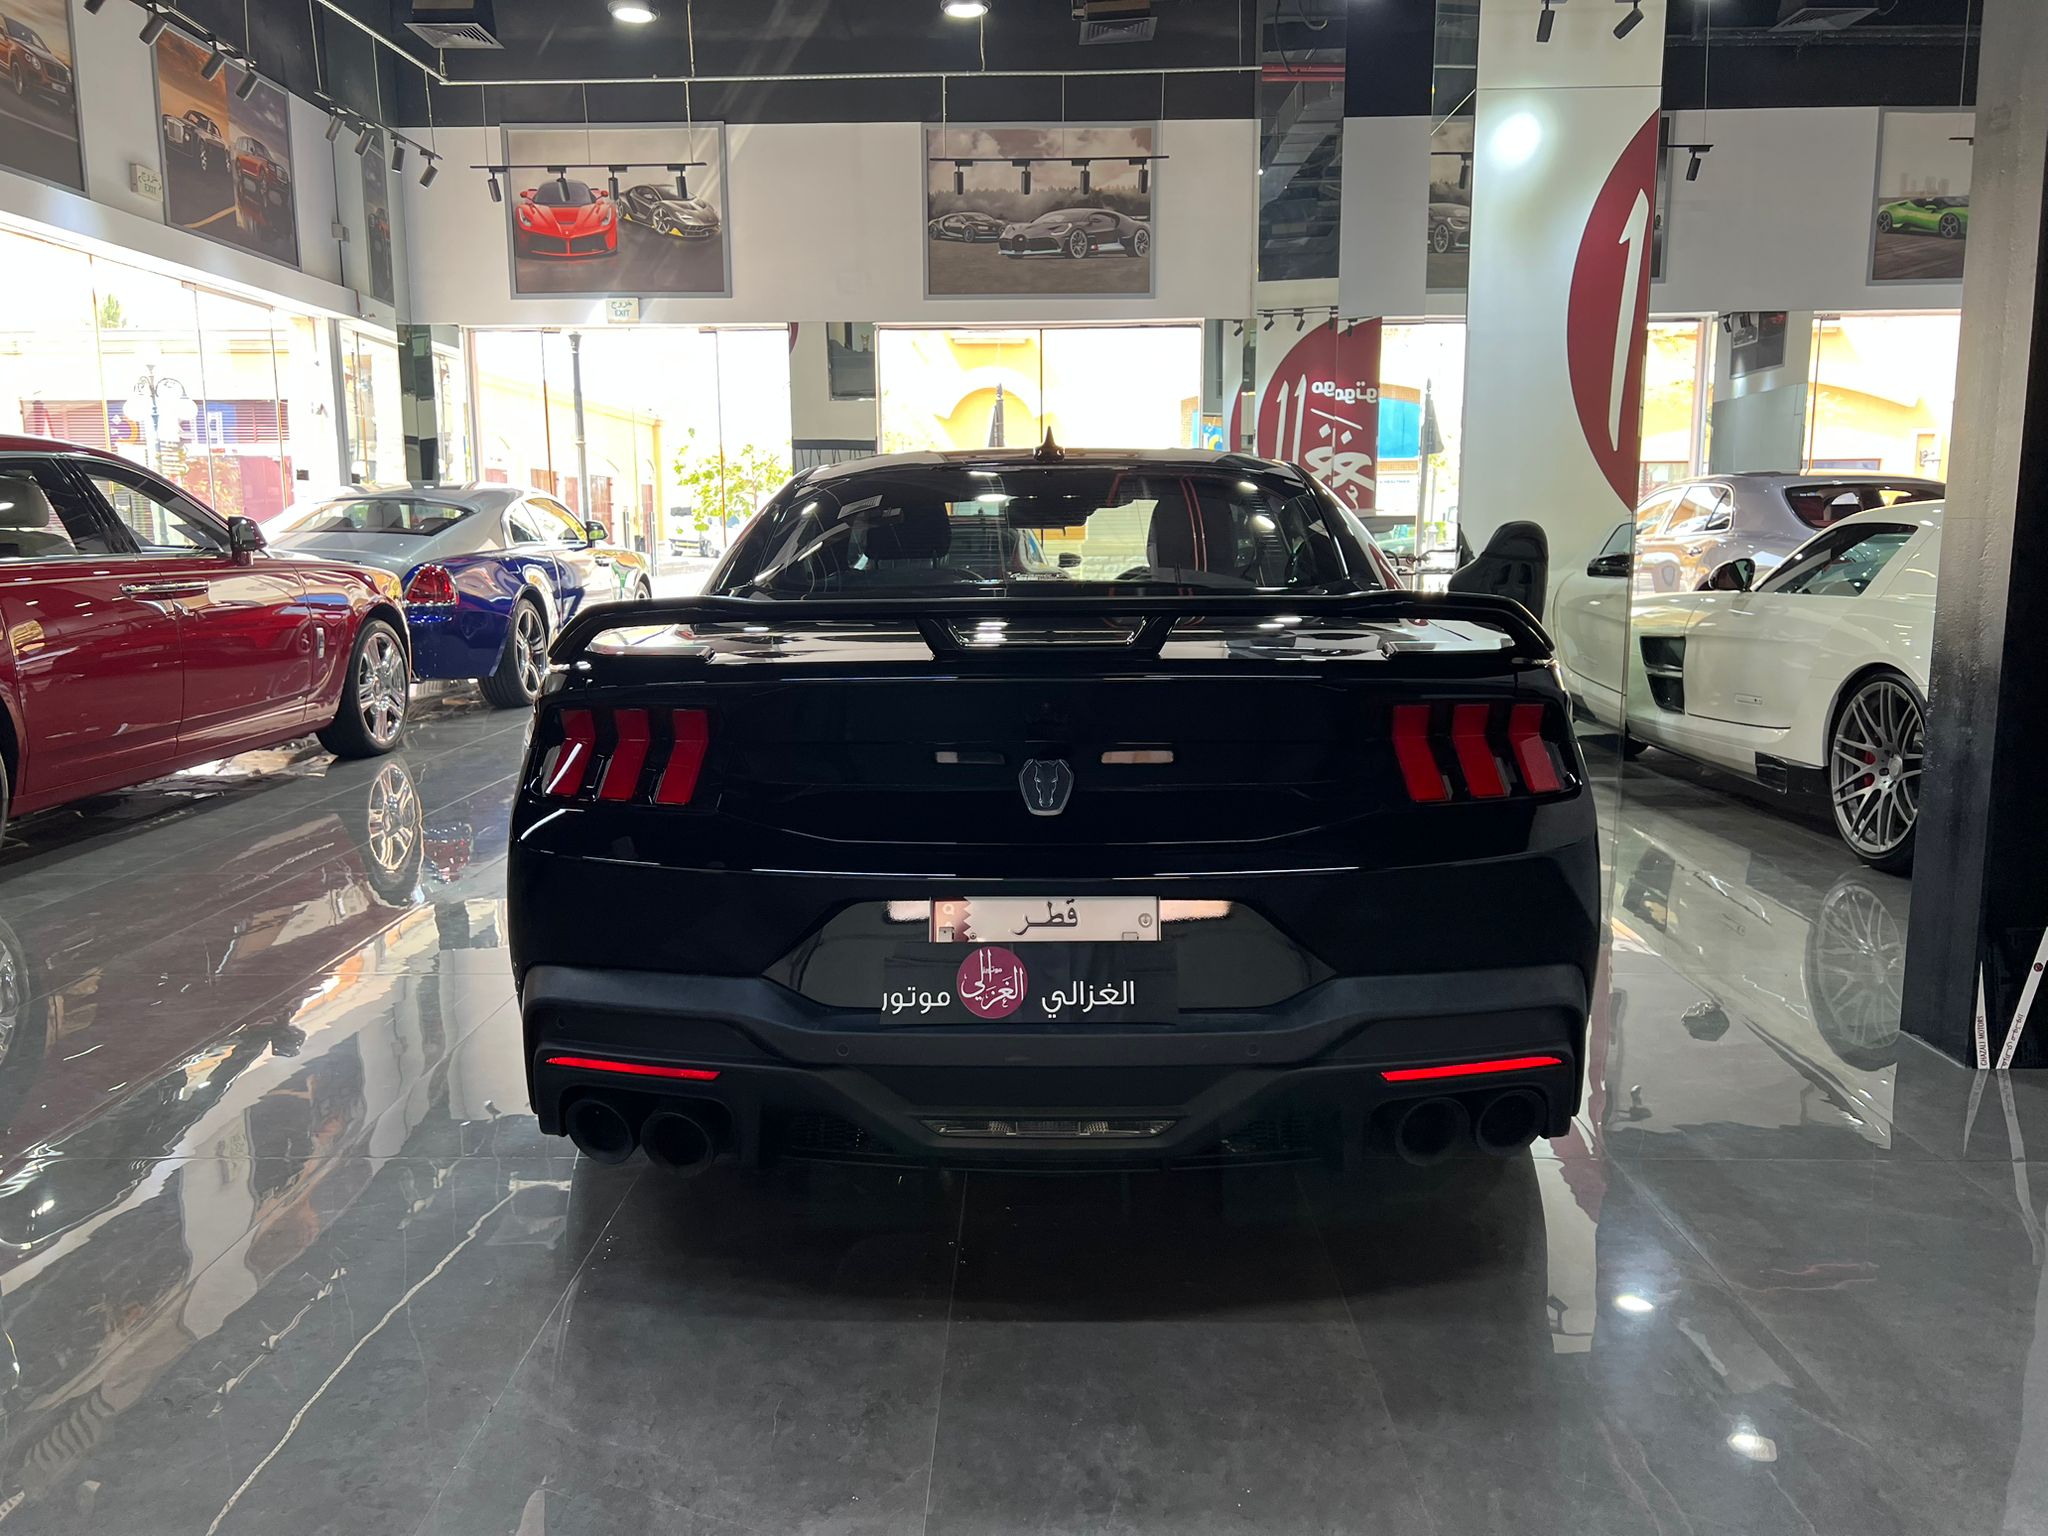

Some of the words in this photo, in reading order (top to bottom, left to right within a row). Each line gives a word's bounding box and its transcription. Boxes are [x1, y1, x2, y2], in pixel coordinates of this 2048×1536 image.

[1011, 898, 1078, 935] قطر
[881, 986, 950, 1014] موتور
[1042, 980, 1135, 1018] الغزالي
[1976, 1015, 1985, 1039] MOTORS
